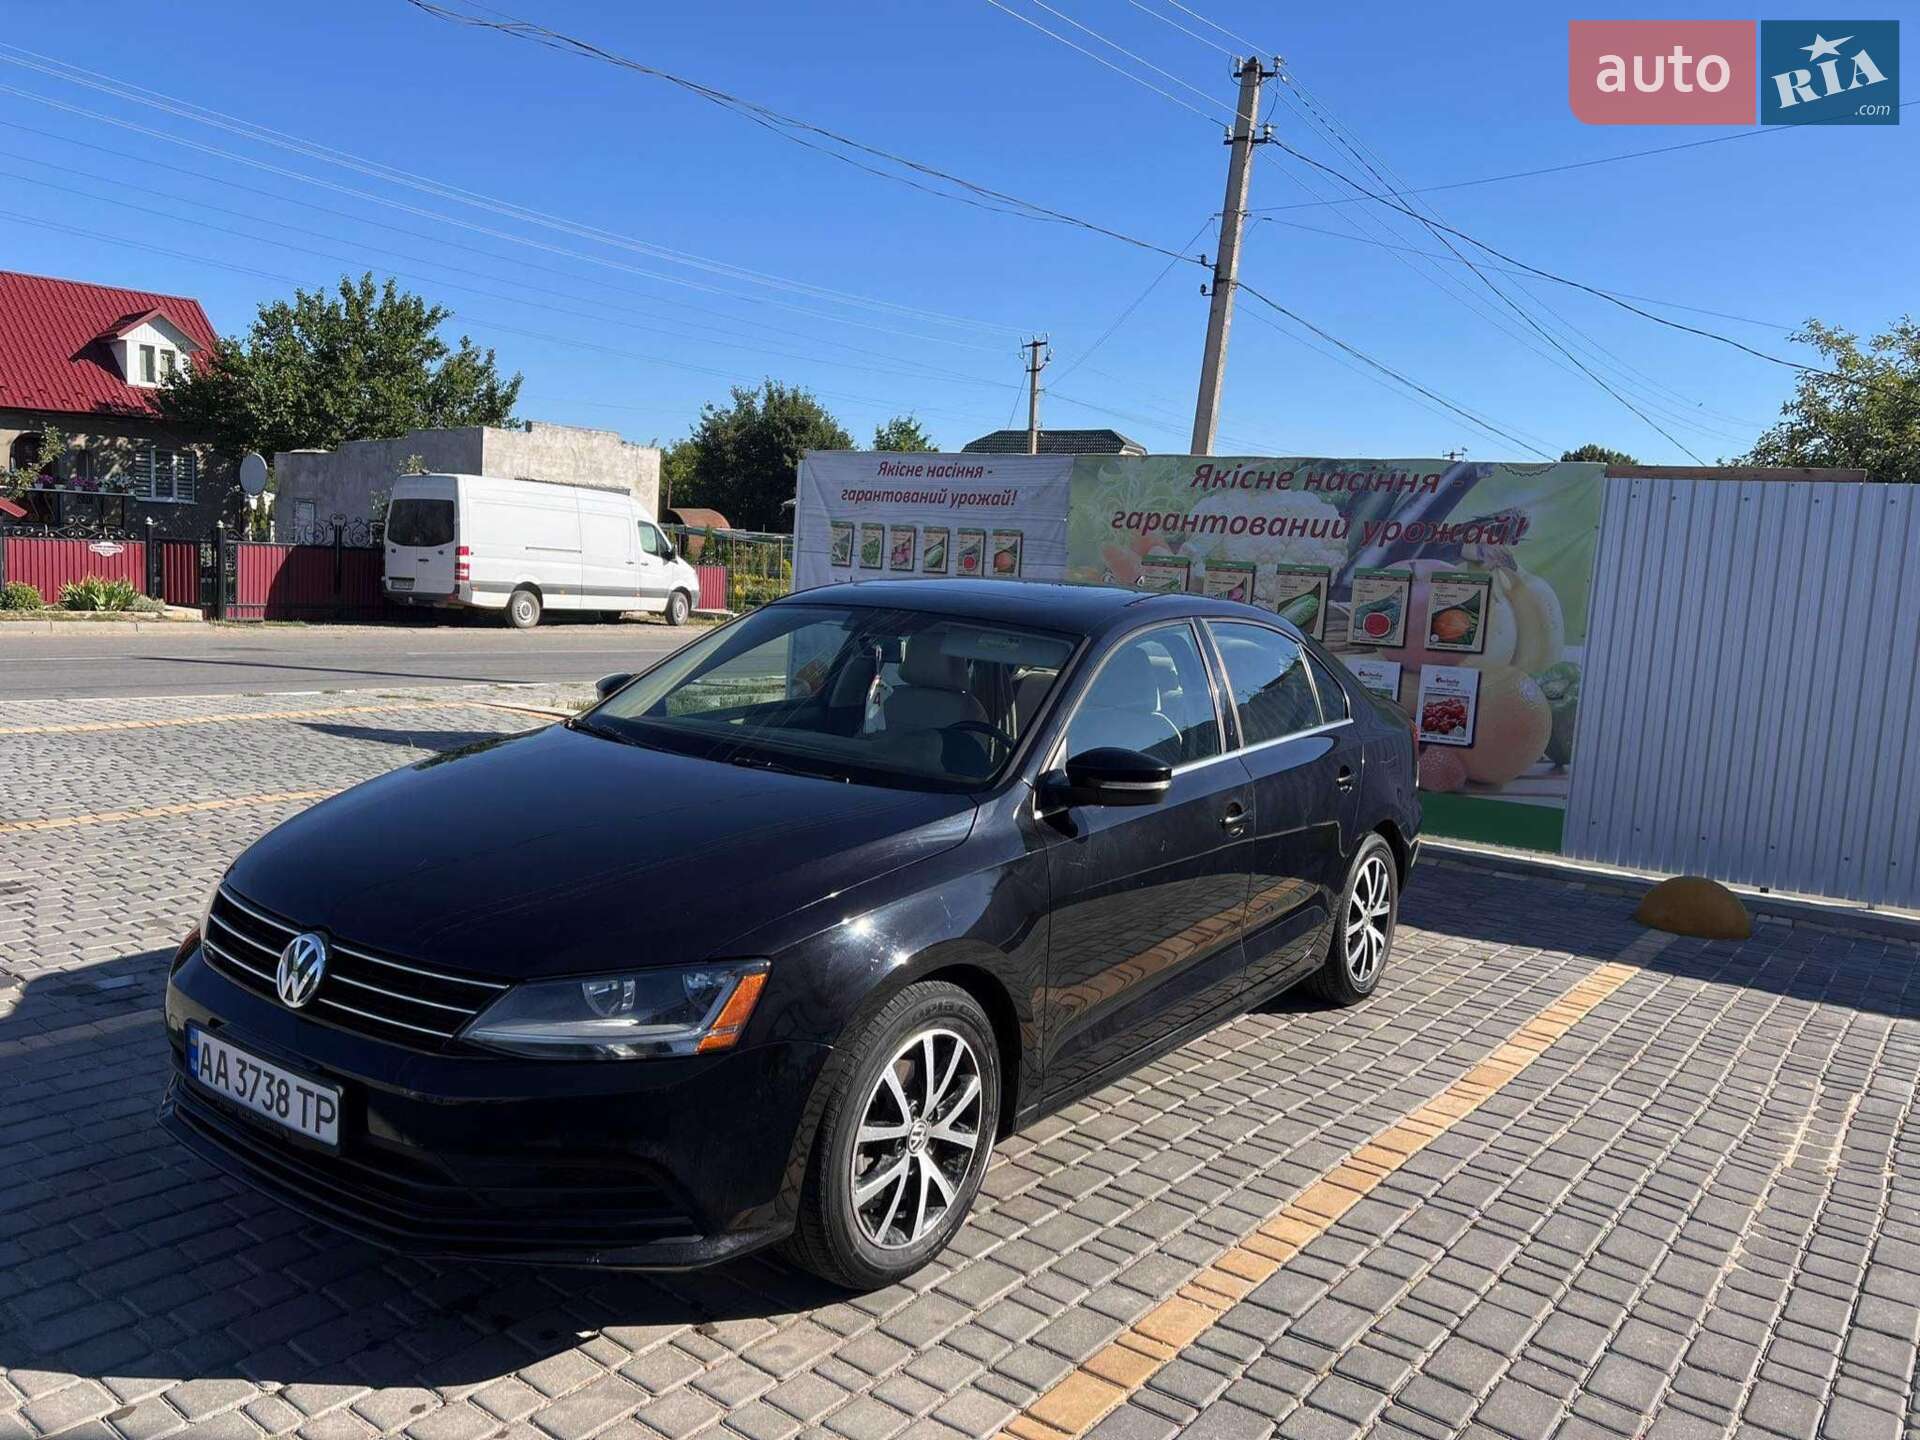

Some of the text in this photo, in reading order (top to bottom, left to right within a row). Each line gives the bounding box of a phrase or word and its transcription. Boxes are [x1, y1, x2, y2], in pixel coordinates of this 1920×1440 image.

[877, 460, 923, 477] Якісне
[926, 463, 984, 479] насіння
[1190, 463, 1295, 492] Якісне
[1303, 466, 1441, 494] насіння
[841, 487, 1017, 509] гарантований урожай!
[1111, 509, 1530, 548] гарантований урожай!
[200, 1042, 337, 1135] AA 3738 TP
